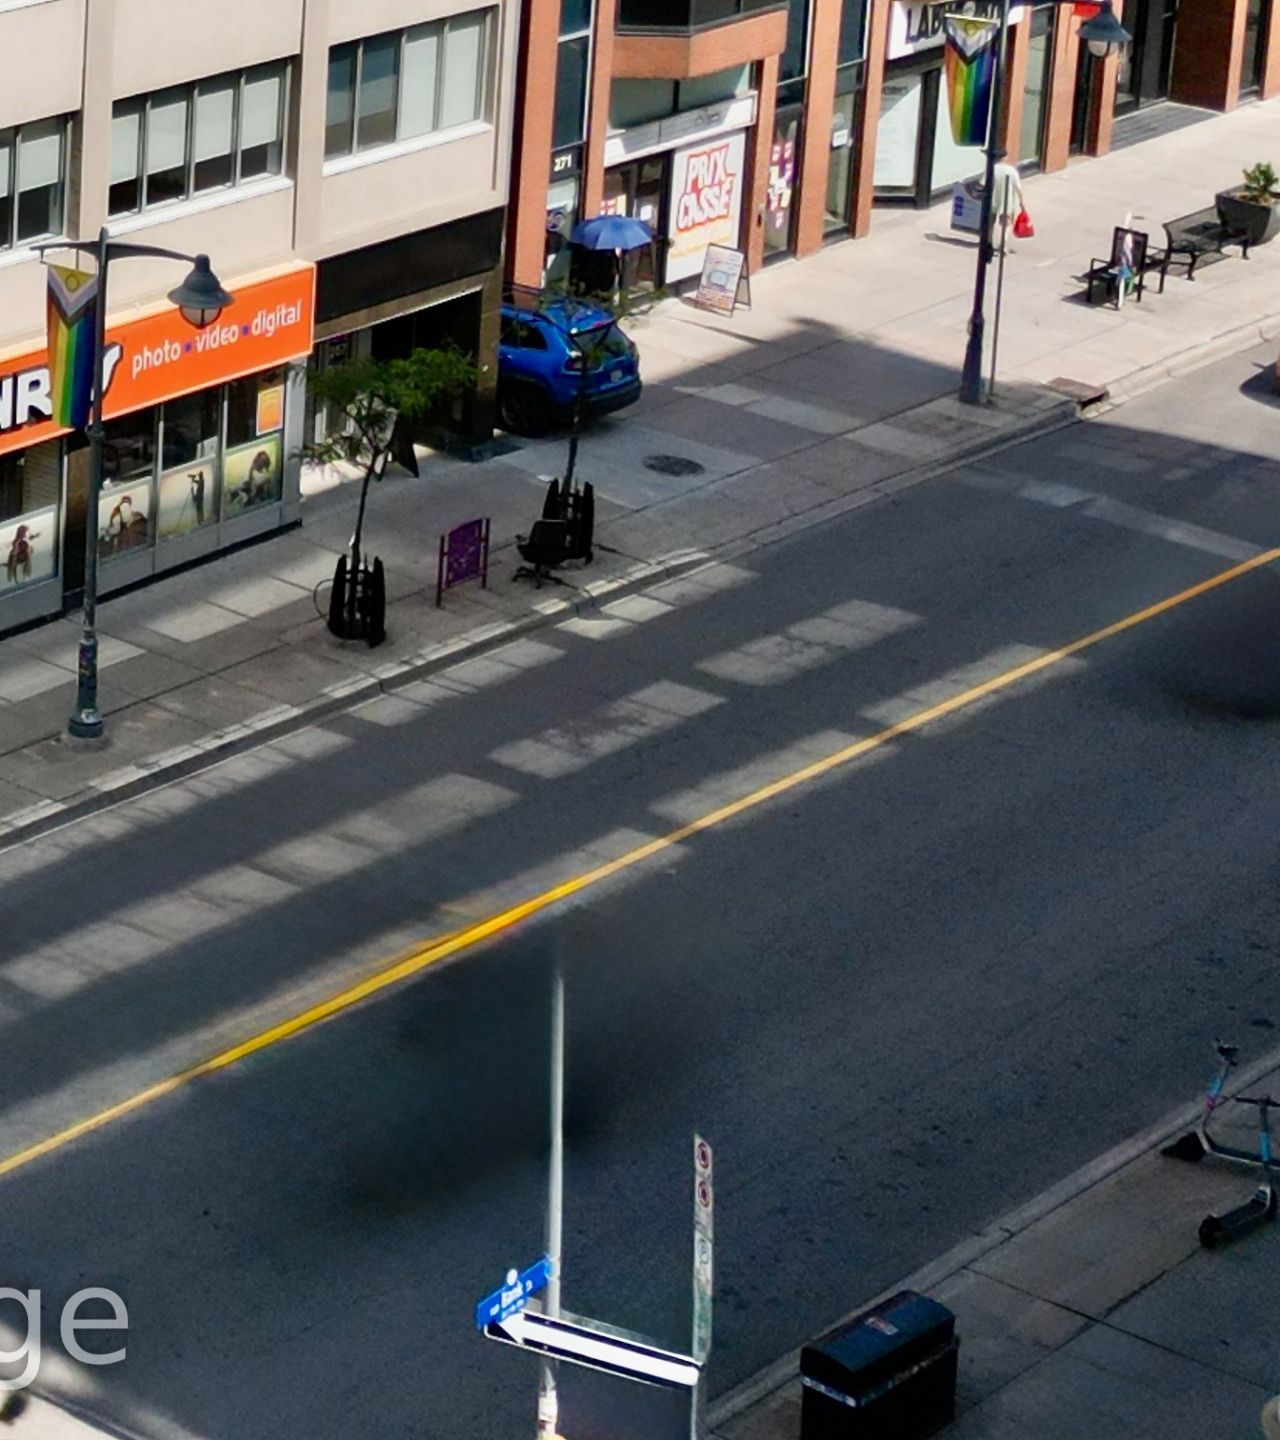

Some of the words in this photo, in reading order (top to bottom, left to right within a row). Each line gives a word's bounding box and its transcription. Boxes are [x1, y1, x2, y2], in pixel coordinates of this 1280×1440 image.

[553, 153, 572, 172] 271
[685, 145, 728, 194] PRIX
[131, 339, 182, 381] photo
[195, 325, 239, 353] video
[251, 299, 303, 337] digital
